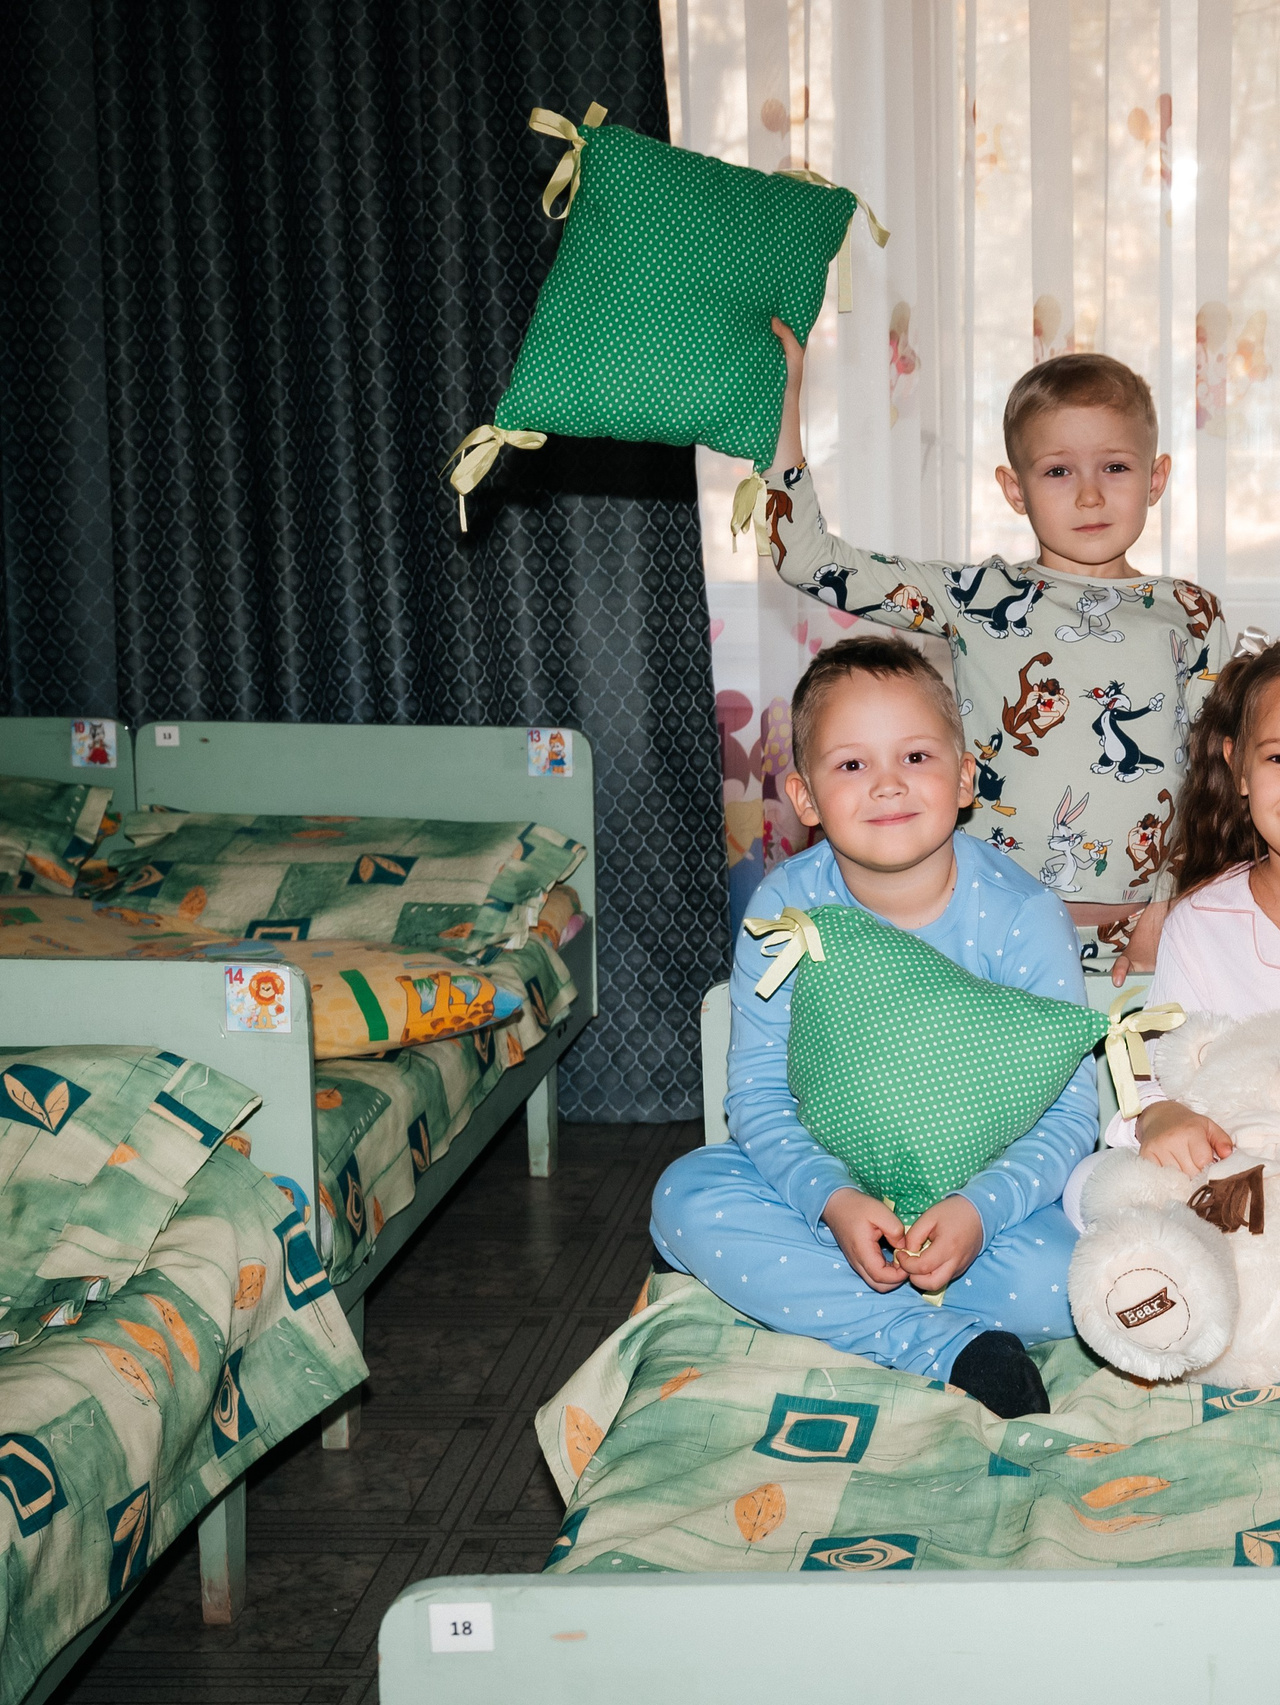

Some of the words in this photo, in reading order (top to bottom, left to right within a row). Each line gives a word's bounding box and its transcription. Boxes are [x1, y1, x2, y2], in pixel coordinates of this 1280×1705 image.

[528, 729, 541, 743] 13
[225, 967, 244, 985] 14
[1124, 1299, 1161, 1325] Bear
[450, 1620, 473, 1636] 18
